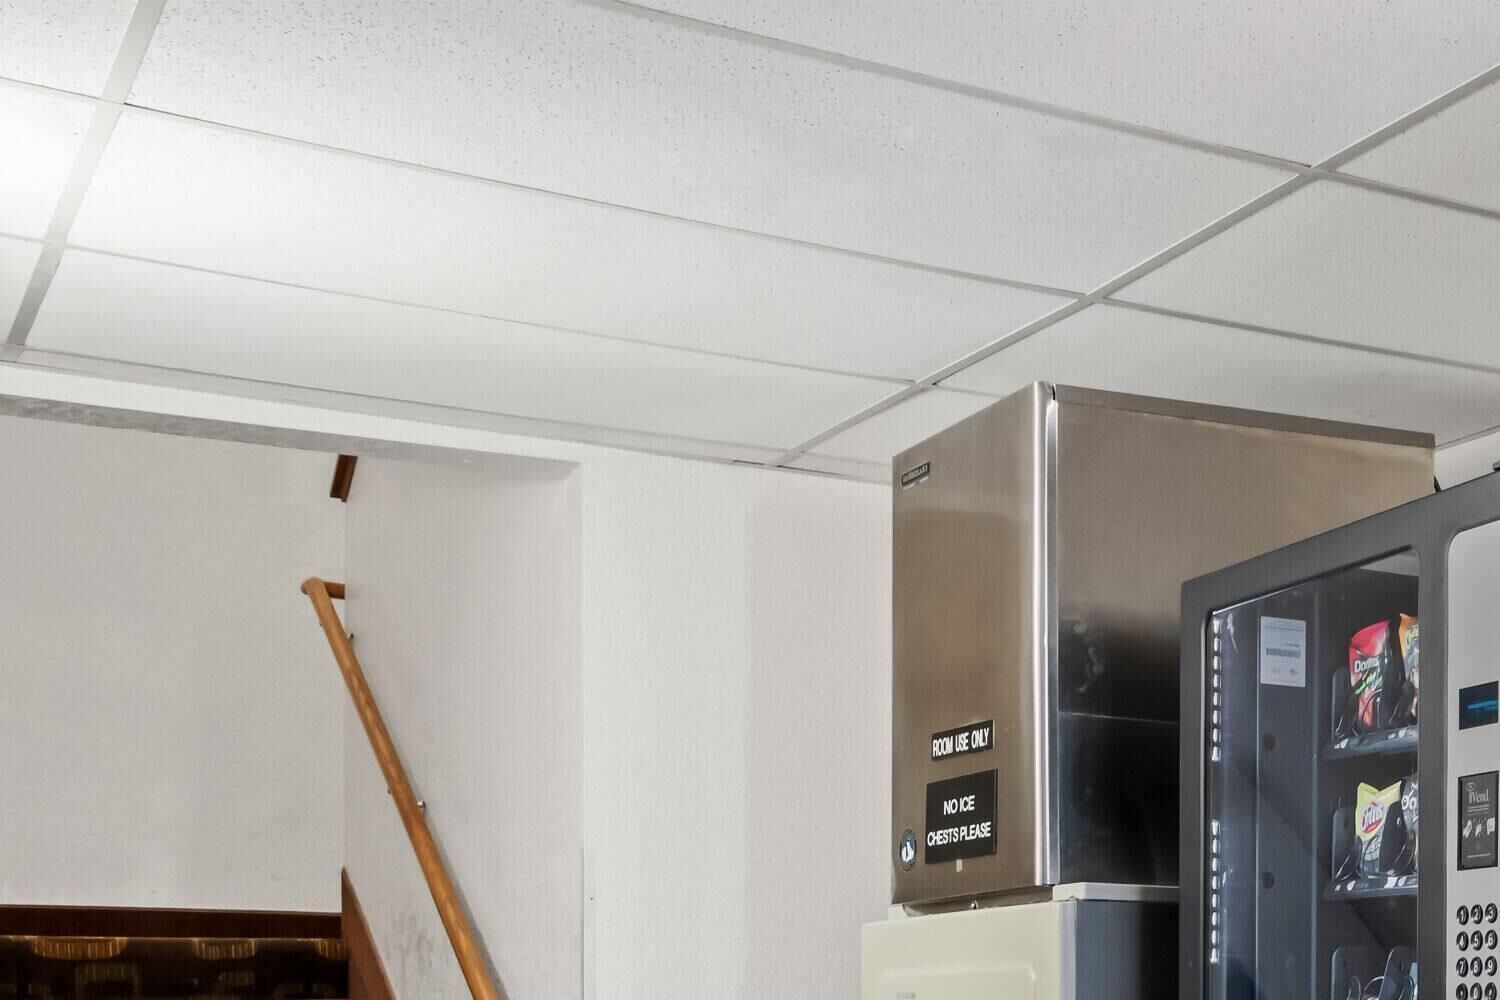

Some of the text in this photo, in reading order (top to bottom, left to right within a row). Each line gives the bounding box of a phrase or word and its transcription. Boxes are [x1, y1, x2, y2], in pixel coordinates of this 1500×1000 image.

[932, 727, 990, 757] ROOM USE ONLY
[943, 795, 975, 815] NO ICE
[927, 822, 991, 846] CHESTS PLEASE
